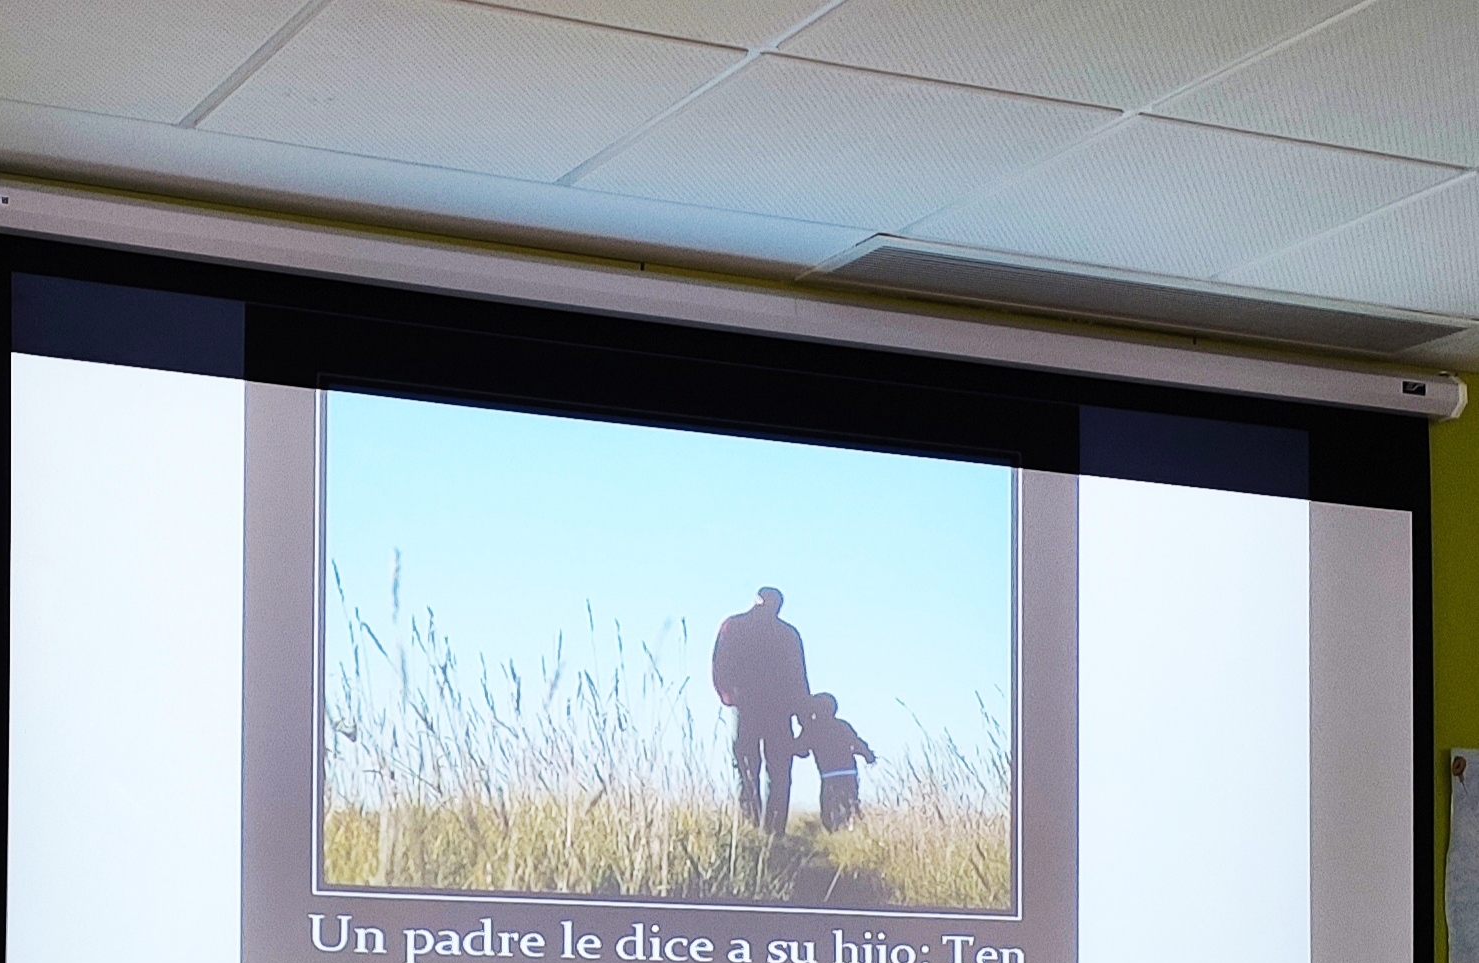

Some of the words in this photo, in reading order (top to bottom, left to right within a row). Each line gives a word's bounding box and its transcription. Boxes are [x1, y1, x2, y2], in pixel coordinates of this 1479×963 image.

[307, 913, 387, 953] Un
[560, 920, 603, 959] le
[615, 923, 715, 962] dice
[727, 937, 753, 963] a
